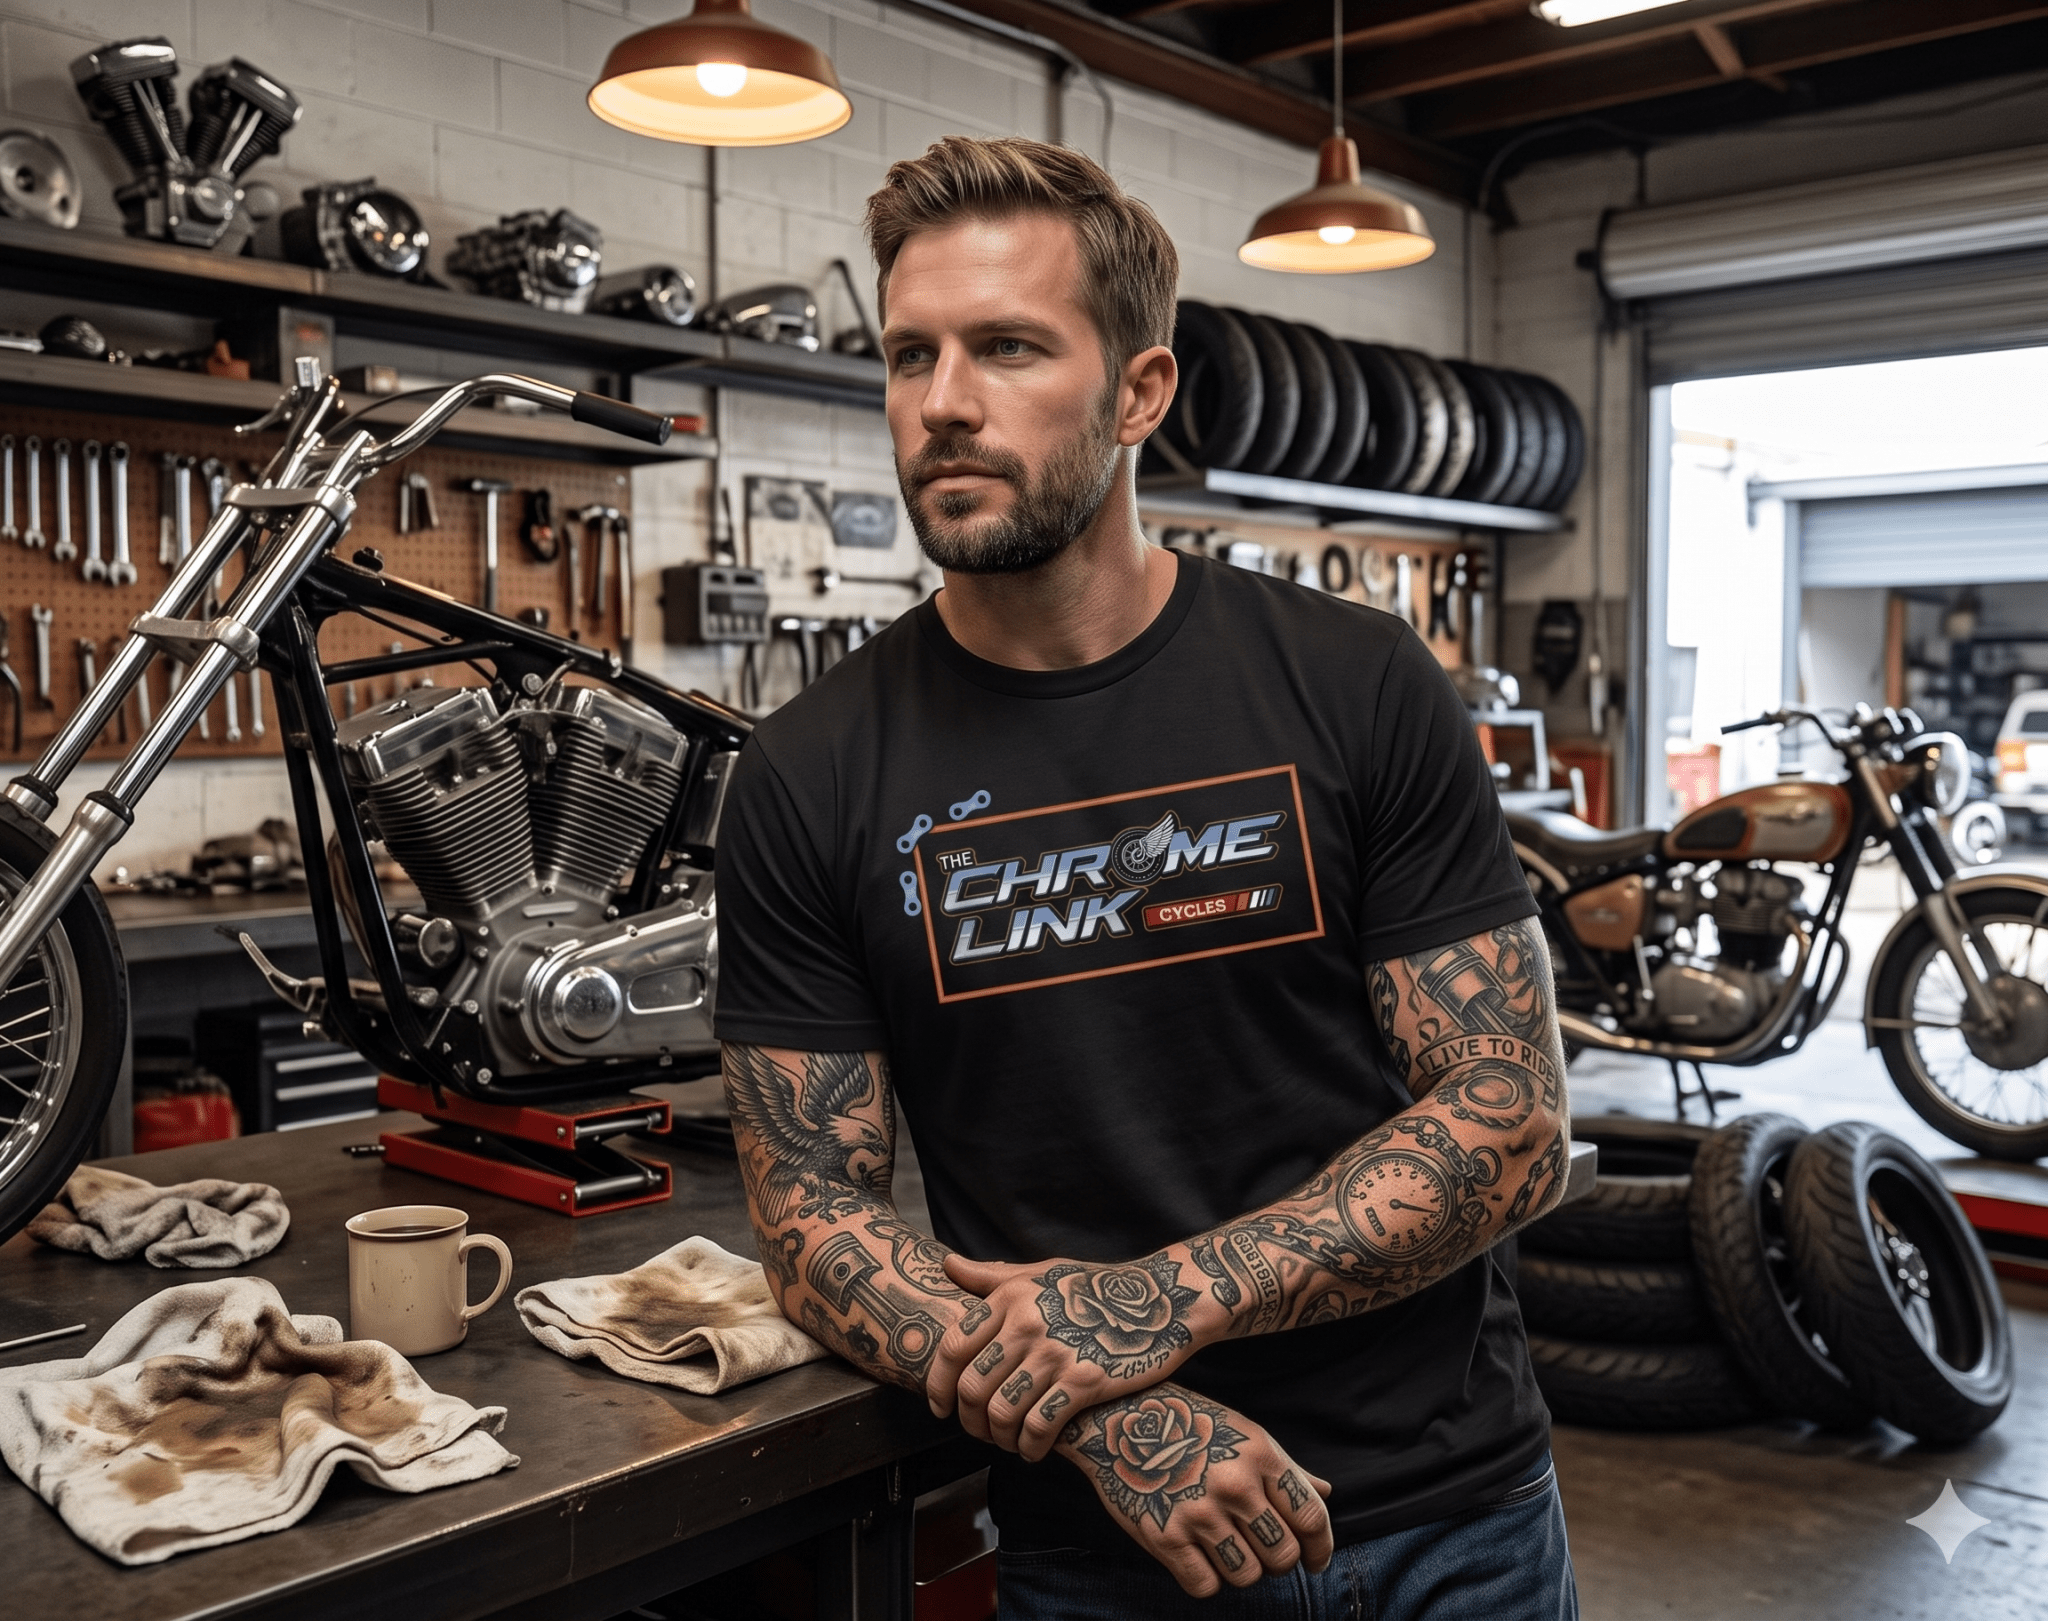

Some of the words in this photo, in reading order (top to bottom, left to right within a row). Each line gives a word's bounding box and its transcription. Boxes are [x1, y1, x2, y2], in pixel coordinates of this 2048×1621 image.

[939, 850, 974, 872] THE
[942, 813, 1283, 912] CHROME
[951, 889, 1141, 962] LINK
[1158, 898, 1227, 923] CYCLES
[1427, 1038, 1482, 1071] LIVE
[1487, 1037, 1515, 1056] TO
[1520, 1044, 1556, 1083] RIDE
